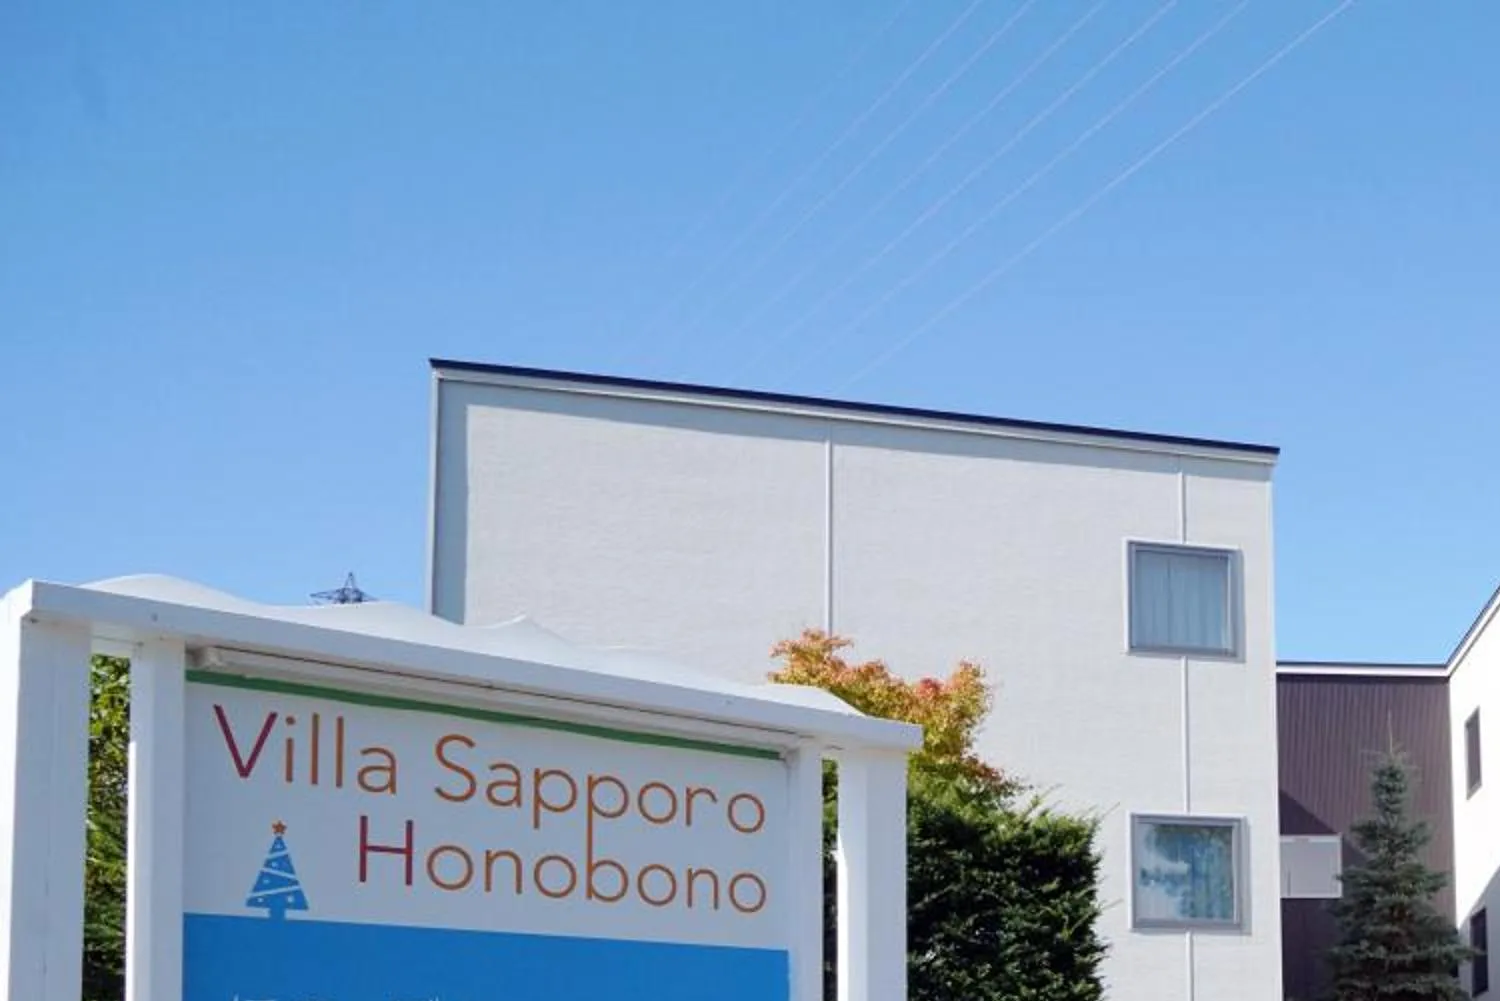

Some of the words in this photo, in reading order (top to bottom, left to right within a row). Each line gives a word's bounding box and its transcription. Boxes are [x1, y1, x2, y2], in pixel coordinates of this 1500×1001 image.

[212, 703, 398, 795] Villa
[433, 733, 766, 834] Sapporo
[358, 815, 767, 914] Honobono
